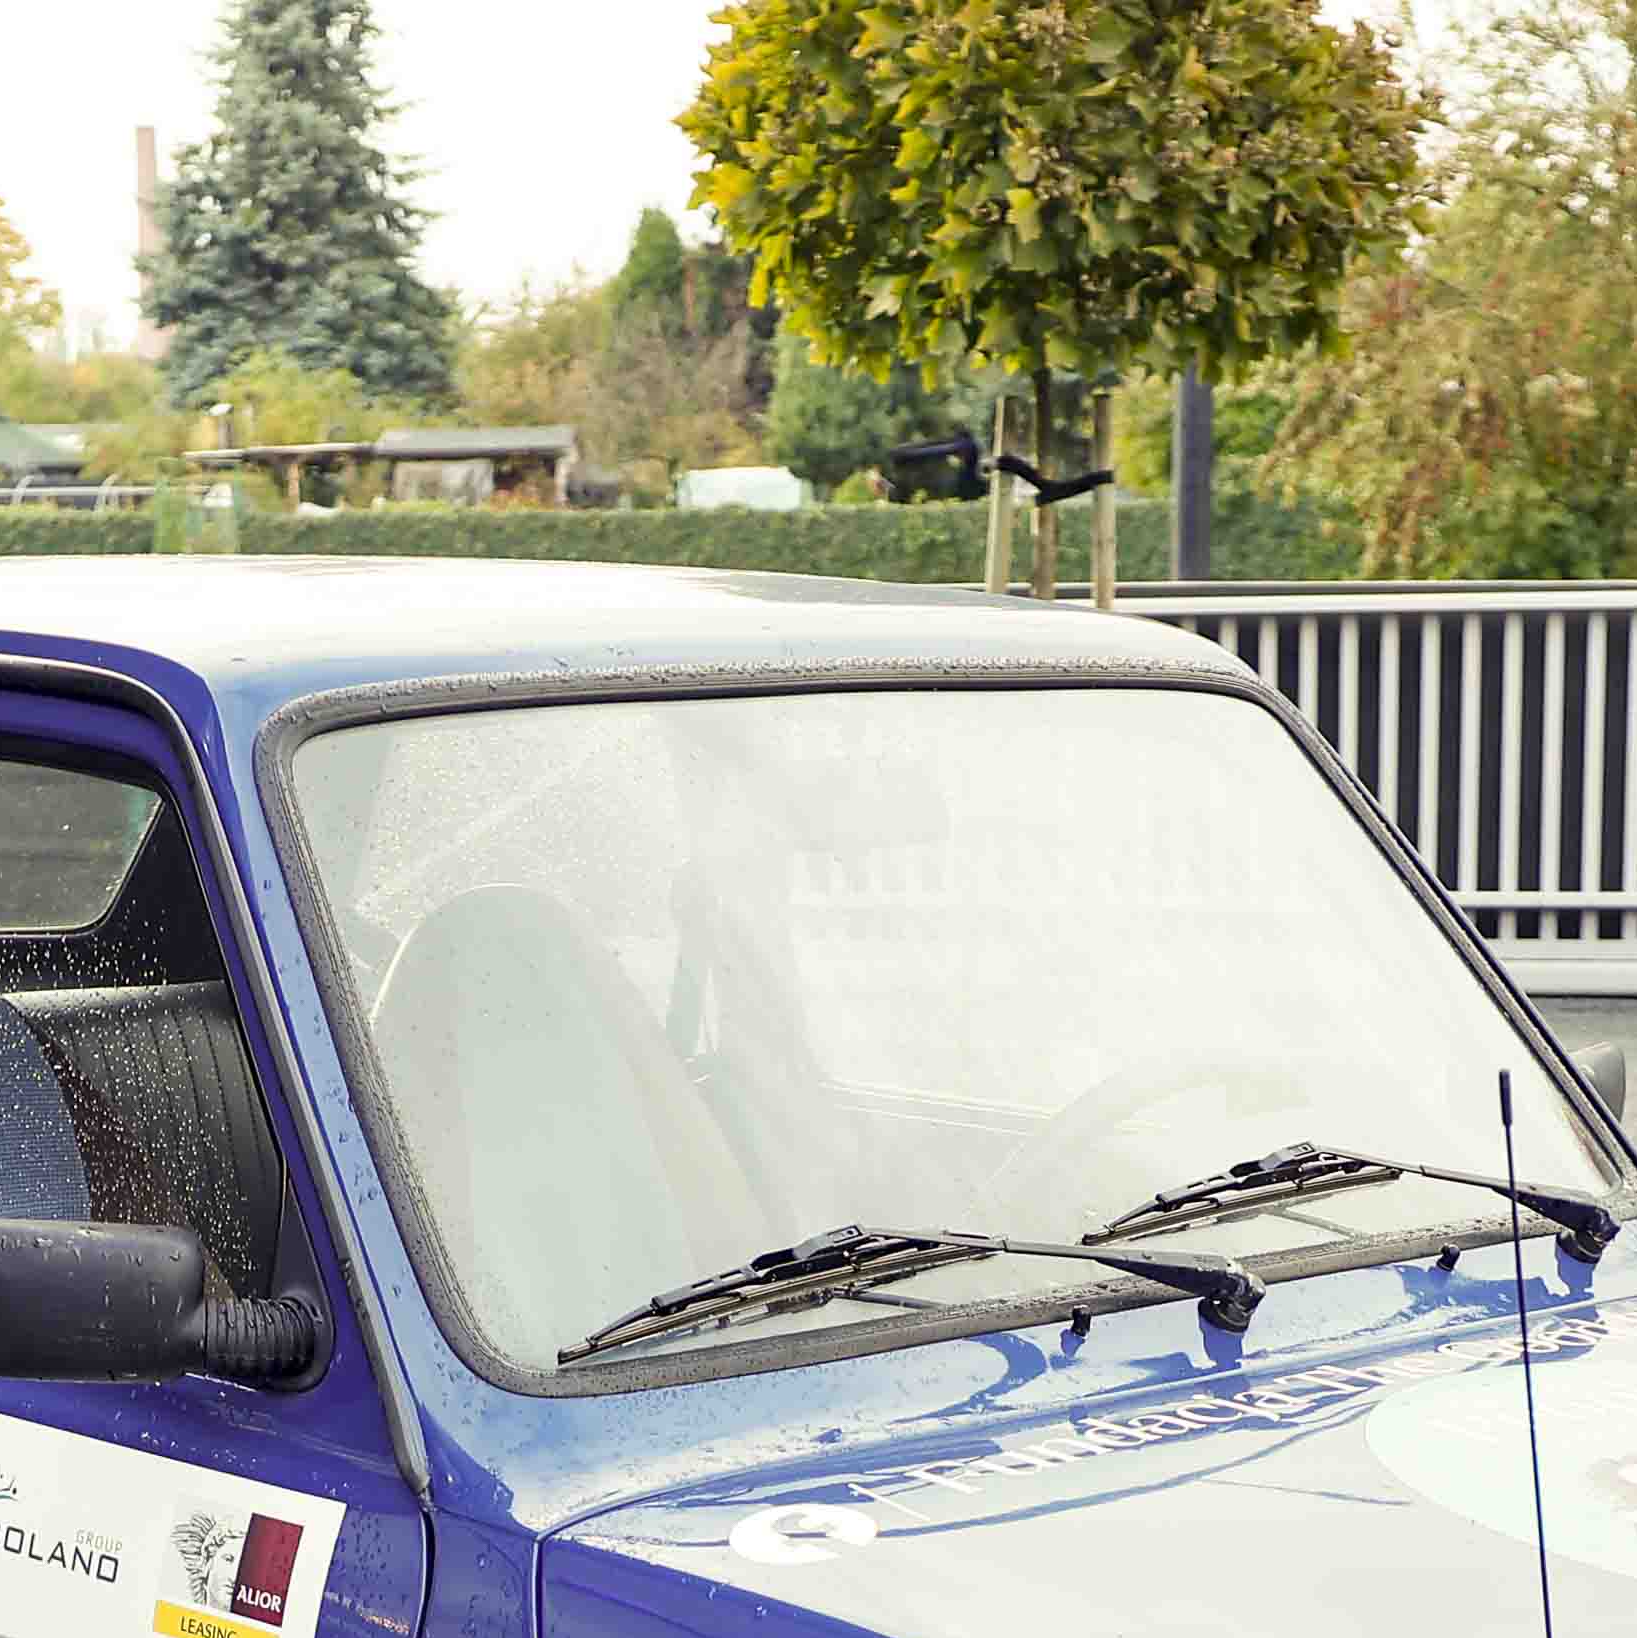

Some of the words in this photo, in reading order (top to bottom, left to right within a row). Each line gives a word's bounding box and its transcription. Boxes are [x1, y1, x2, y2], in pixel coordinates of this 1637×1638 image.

[912, 1391, 1297, 1495] Fundacja
[75, 1529, 123, 1554] GROUP
[237, 1584, 282, 1614] ALIOR
